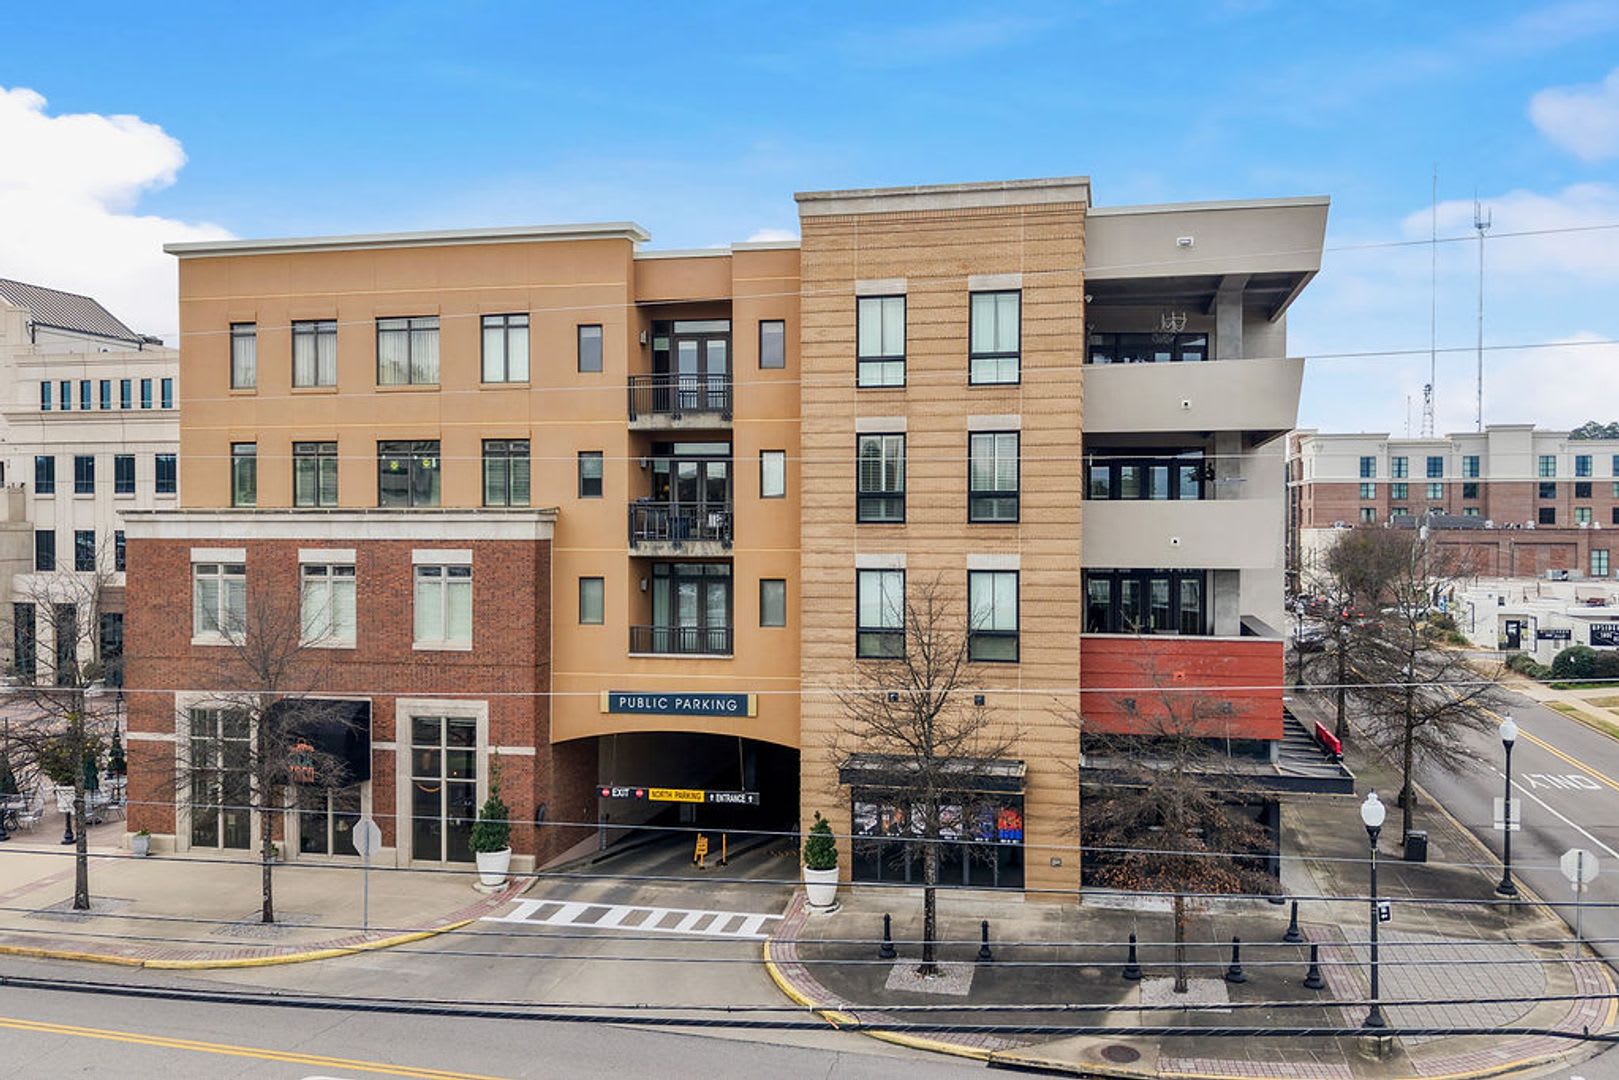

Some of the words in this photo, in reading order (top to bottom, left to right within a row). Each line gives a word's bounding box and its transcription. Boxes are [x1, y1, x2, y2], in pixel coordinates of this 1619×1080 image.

[619, 697, 668, 709] PUBLIC
[675, 699, 737, 711] PARKING
[1522, 773, 1602, 790] ONLY
[612, 788, 630, 797] EXIT
[651, 791, 672, 799] NORTH
[675, 792, 702, 800] PARKING
[716, 794, 746, 804] ENTRANCE
